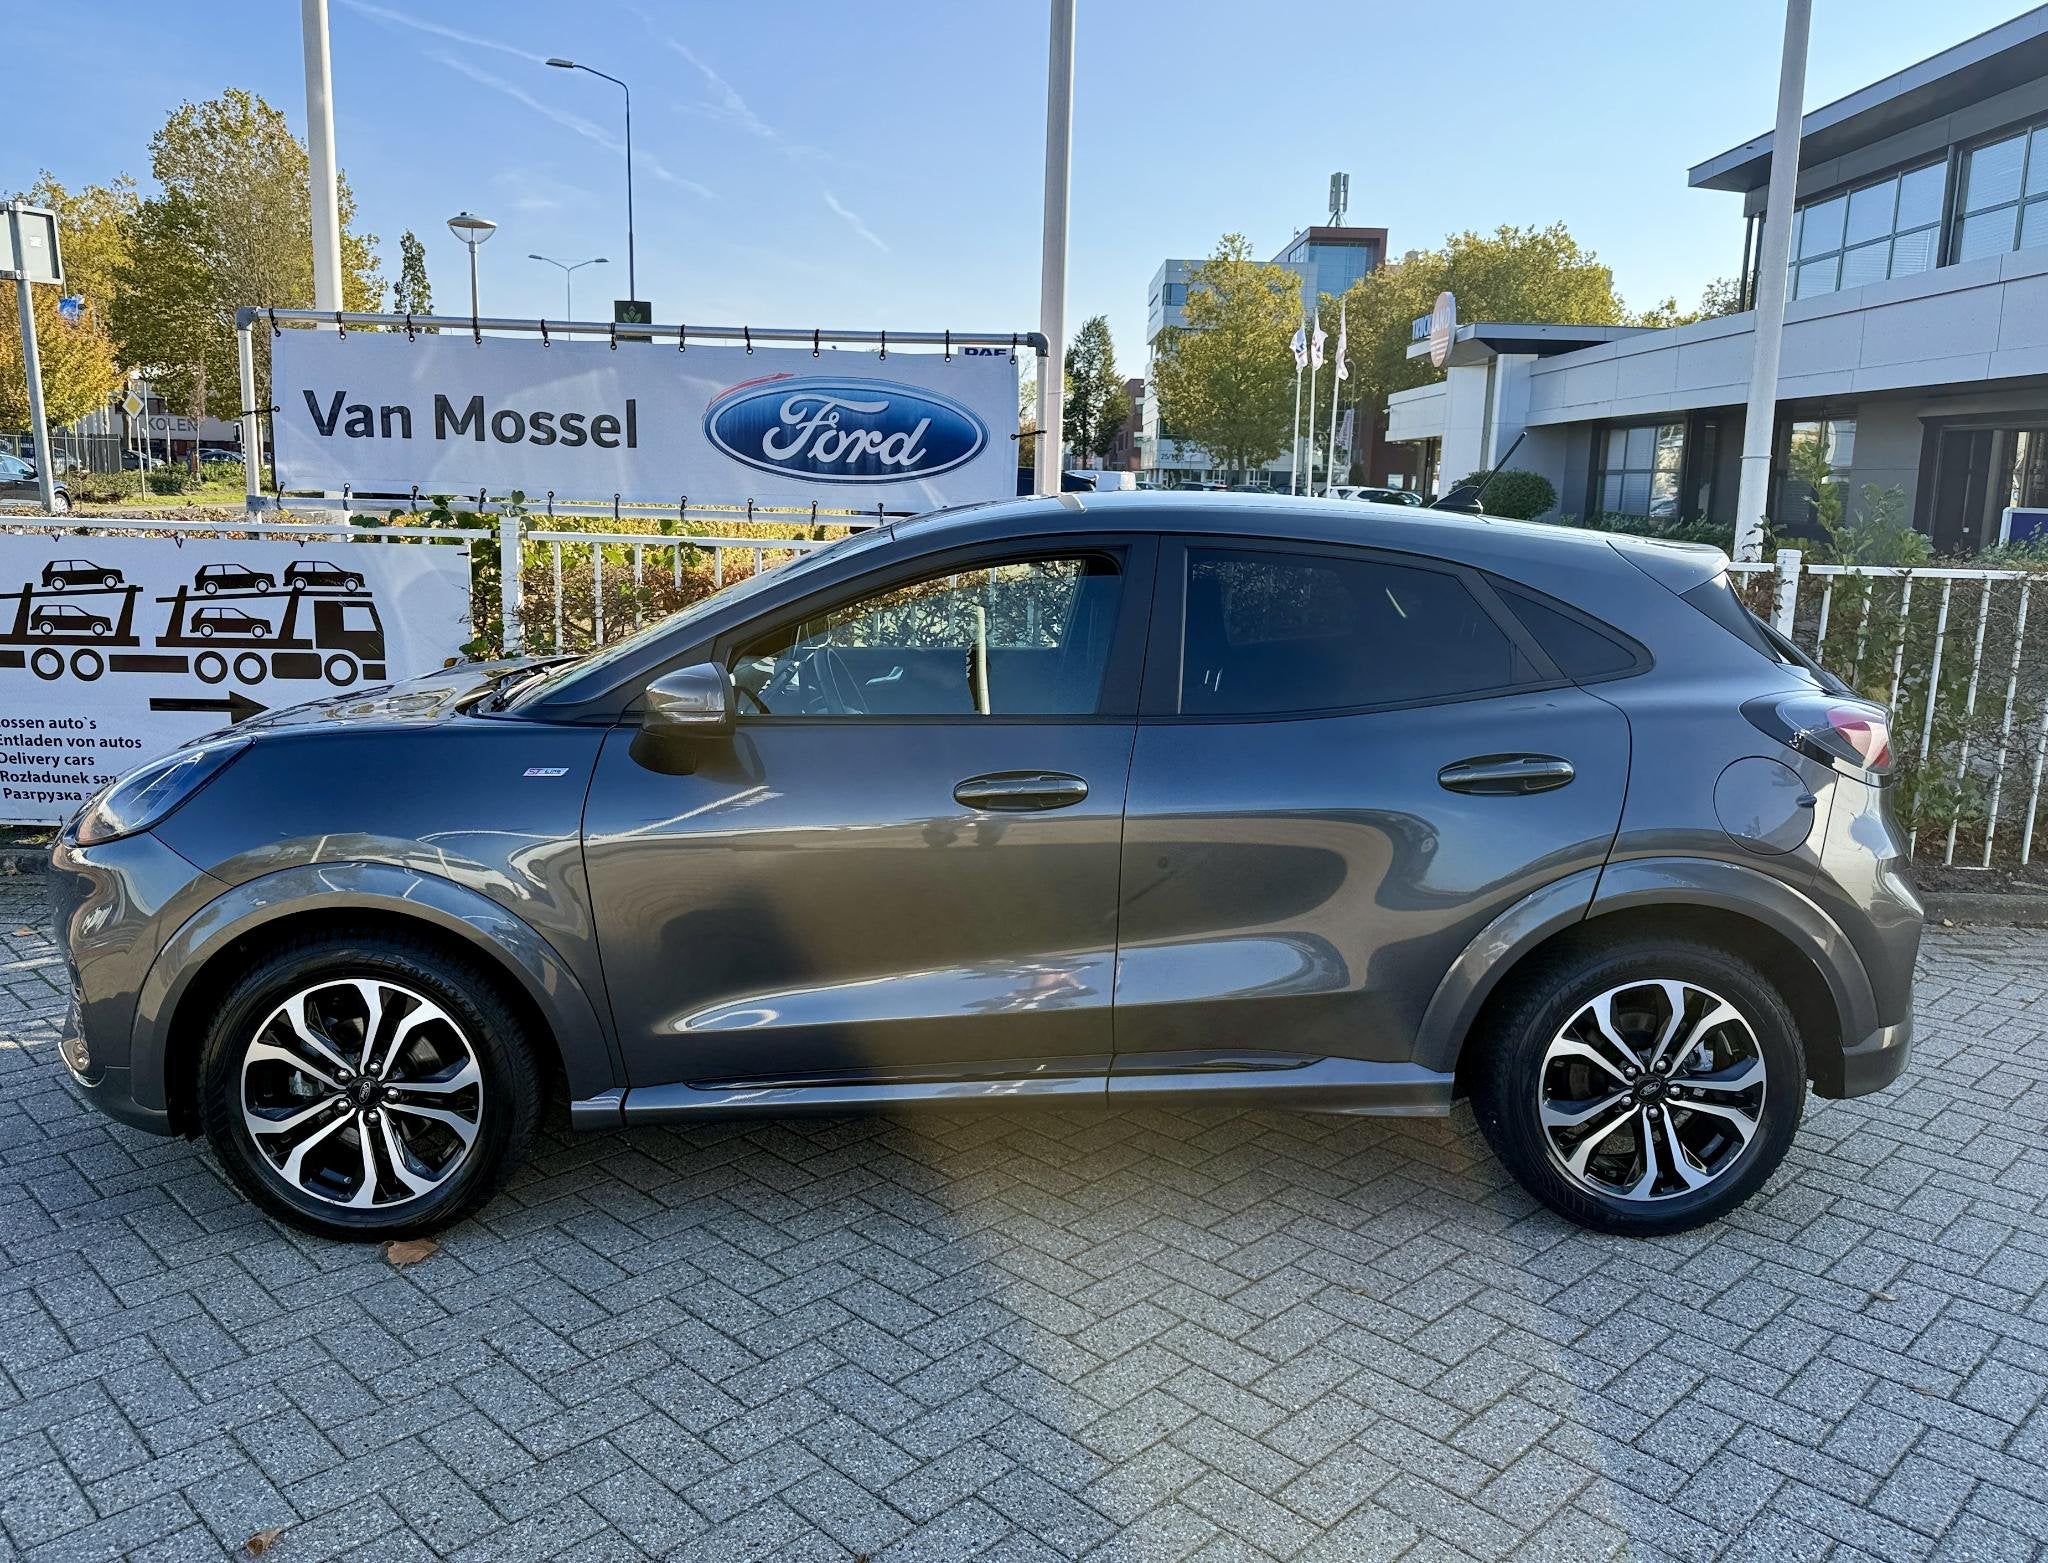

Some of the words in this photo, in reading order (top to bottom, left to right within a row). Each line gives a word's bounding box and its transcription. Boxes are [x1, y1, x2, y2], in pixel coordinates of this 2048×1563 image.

[965, 347, 1007, 356] DAF
[302, 389, 412, 440] Van
[434, 394, 637, 448] Mossel
[762, 393, 932, 466] Ford
[0, 718, 45, 729] ossen
[66, 737, 95, 748] von
[99, 736, 142, 749] autos
[0, 752, 60, 768] Delivery
[64, 756, 95, 766] cars
[0, 771, 90, 784] Rozładunek
[3, 787, 82, 802] Разгрузка
